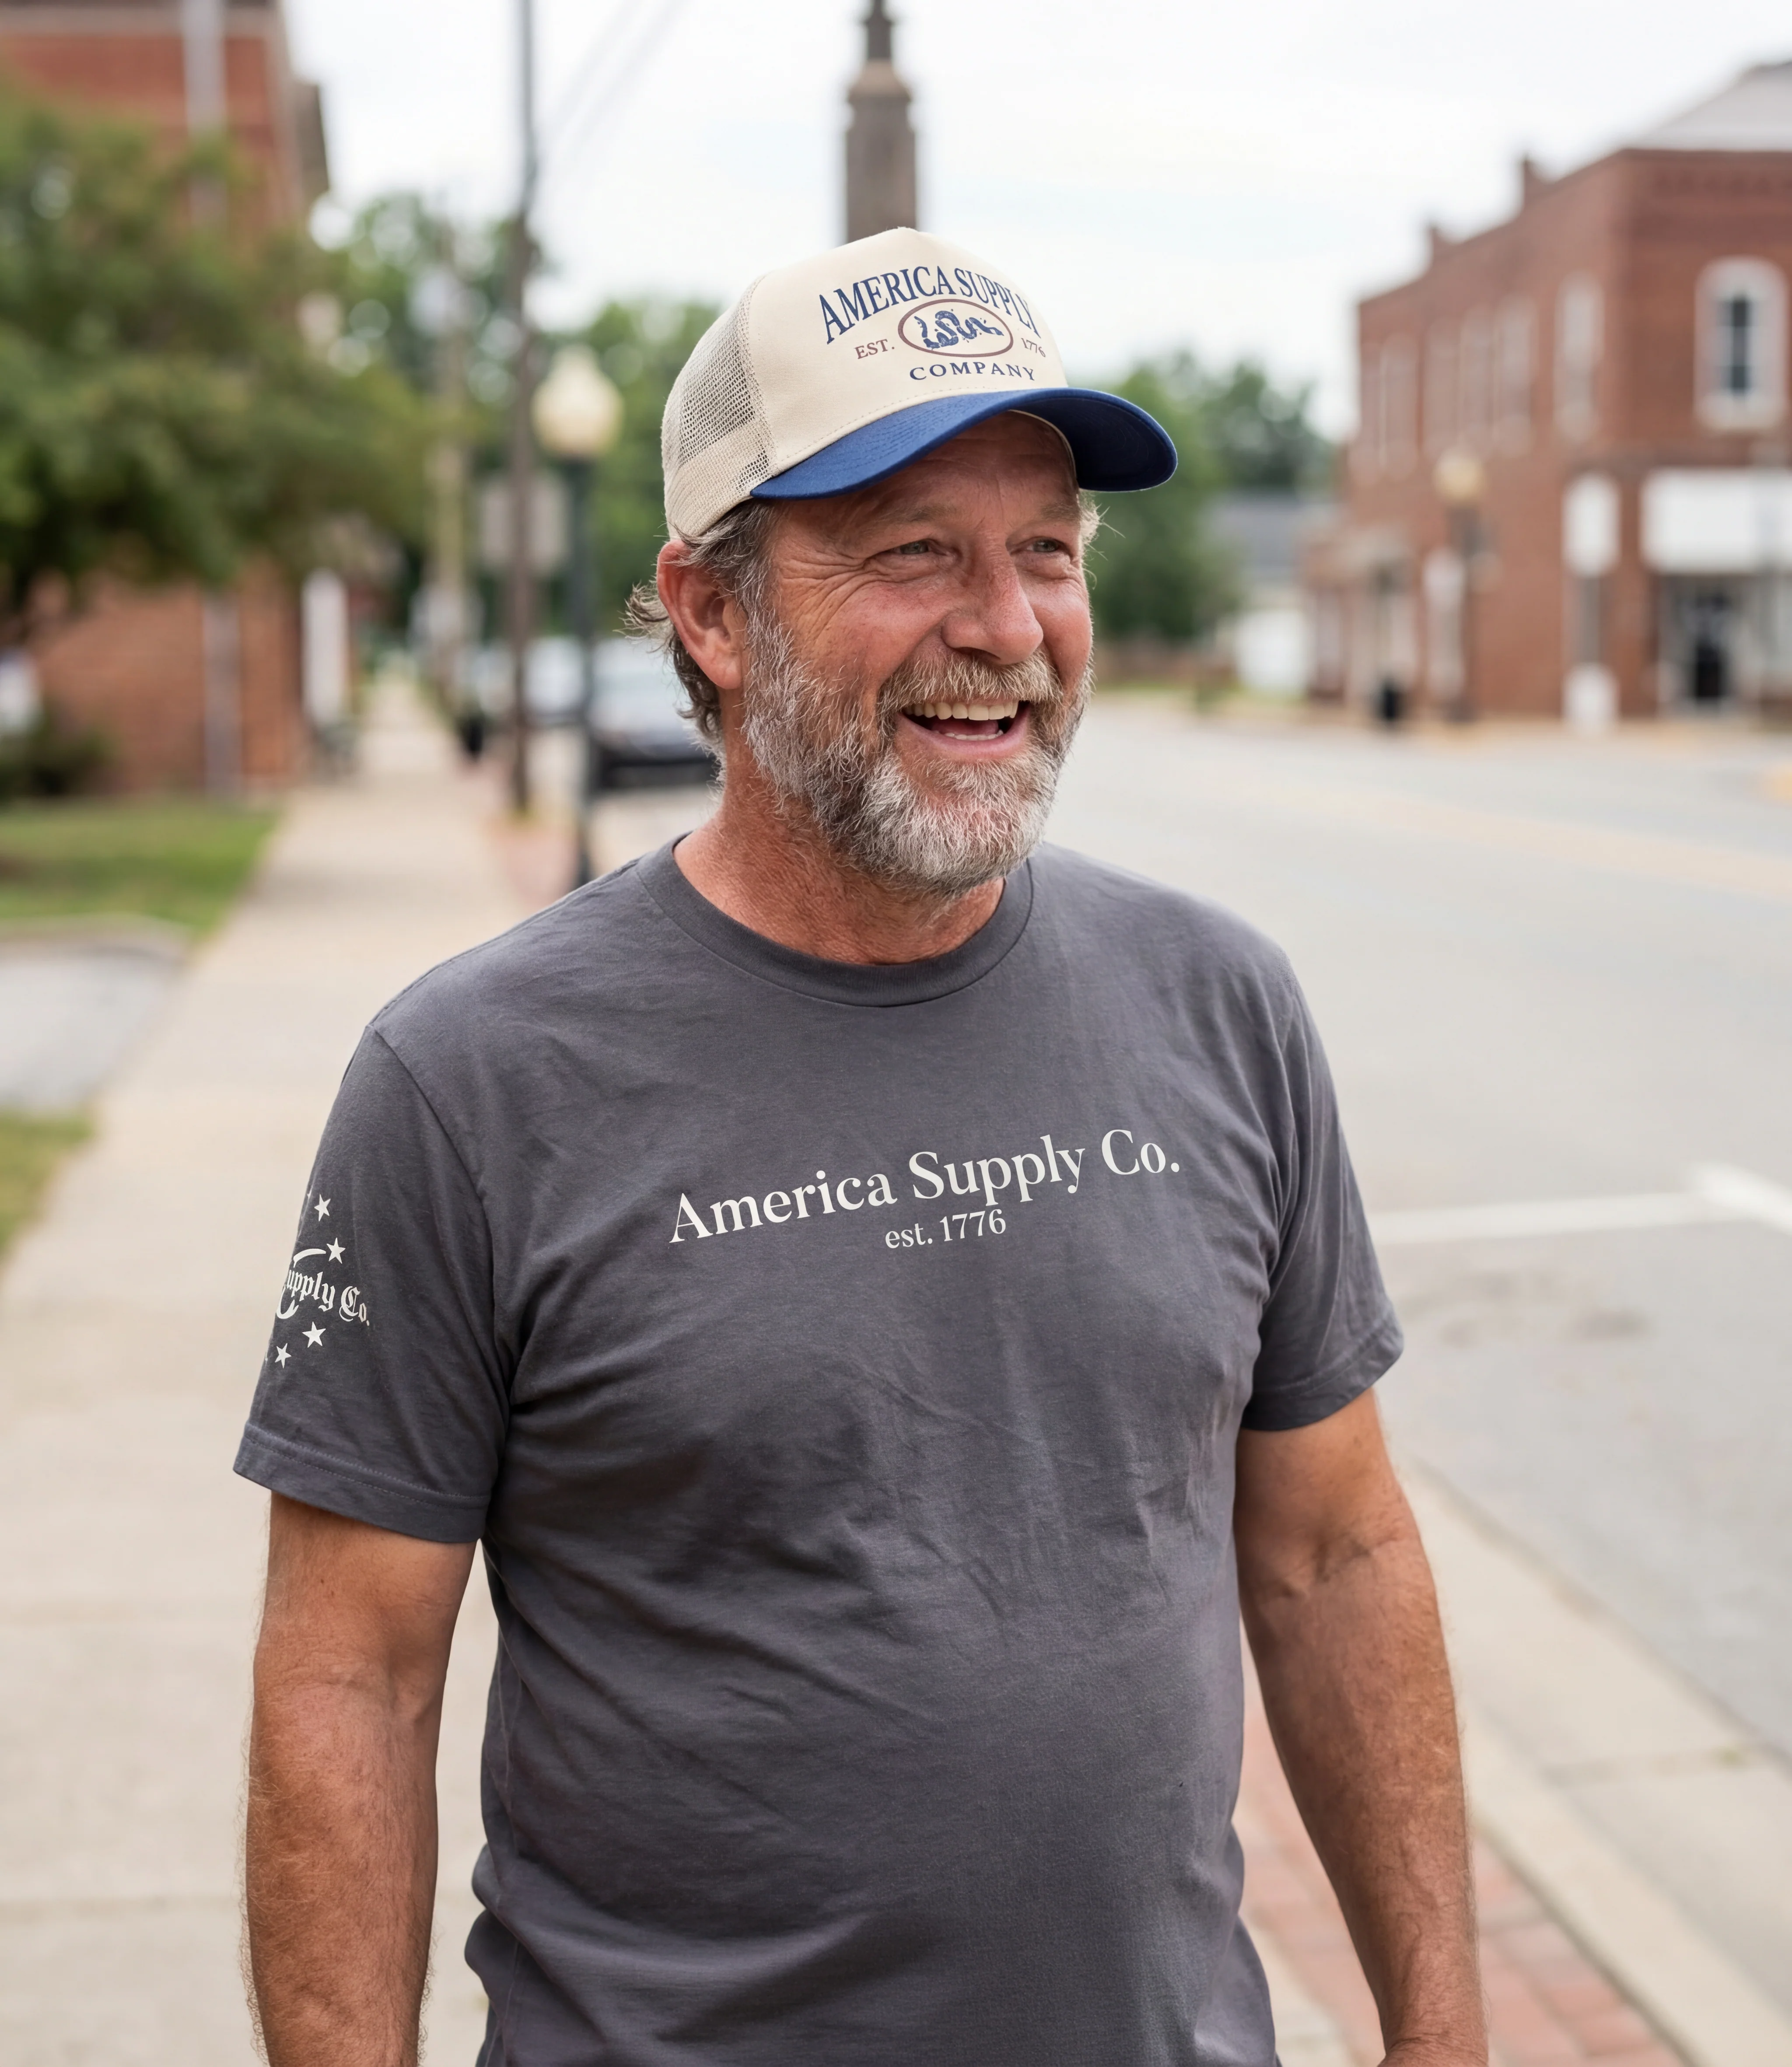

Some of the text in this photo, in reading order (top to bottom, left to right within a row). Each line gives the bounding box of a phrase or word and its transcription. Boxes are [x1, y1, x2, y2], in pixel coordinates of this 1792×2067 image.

[819, 266, 1041, 344] AMERICA SUPPLY
[854, 338, 1046, 359] EST. 1776
[910, 362, 1035, 381] COMPANY
[669, 1129, 1180, 1243] America Supply Co.
[885, 1209, 1007, 1248] est. 1776
[339, 1286, 370, 1326] Co.
